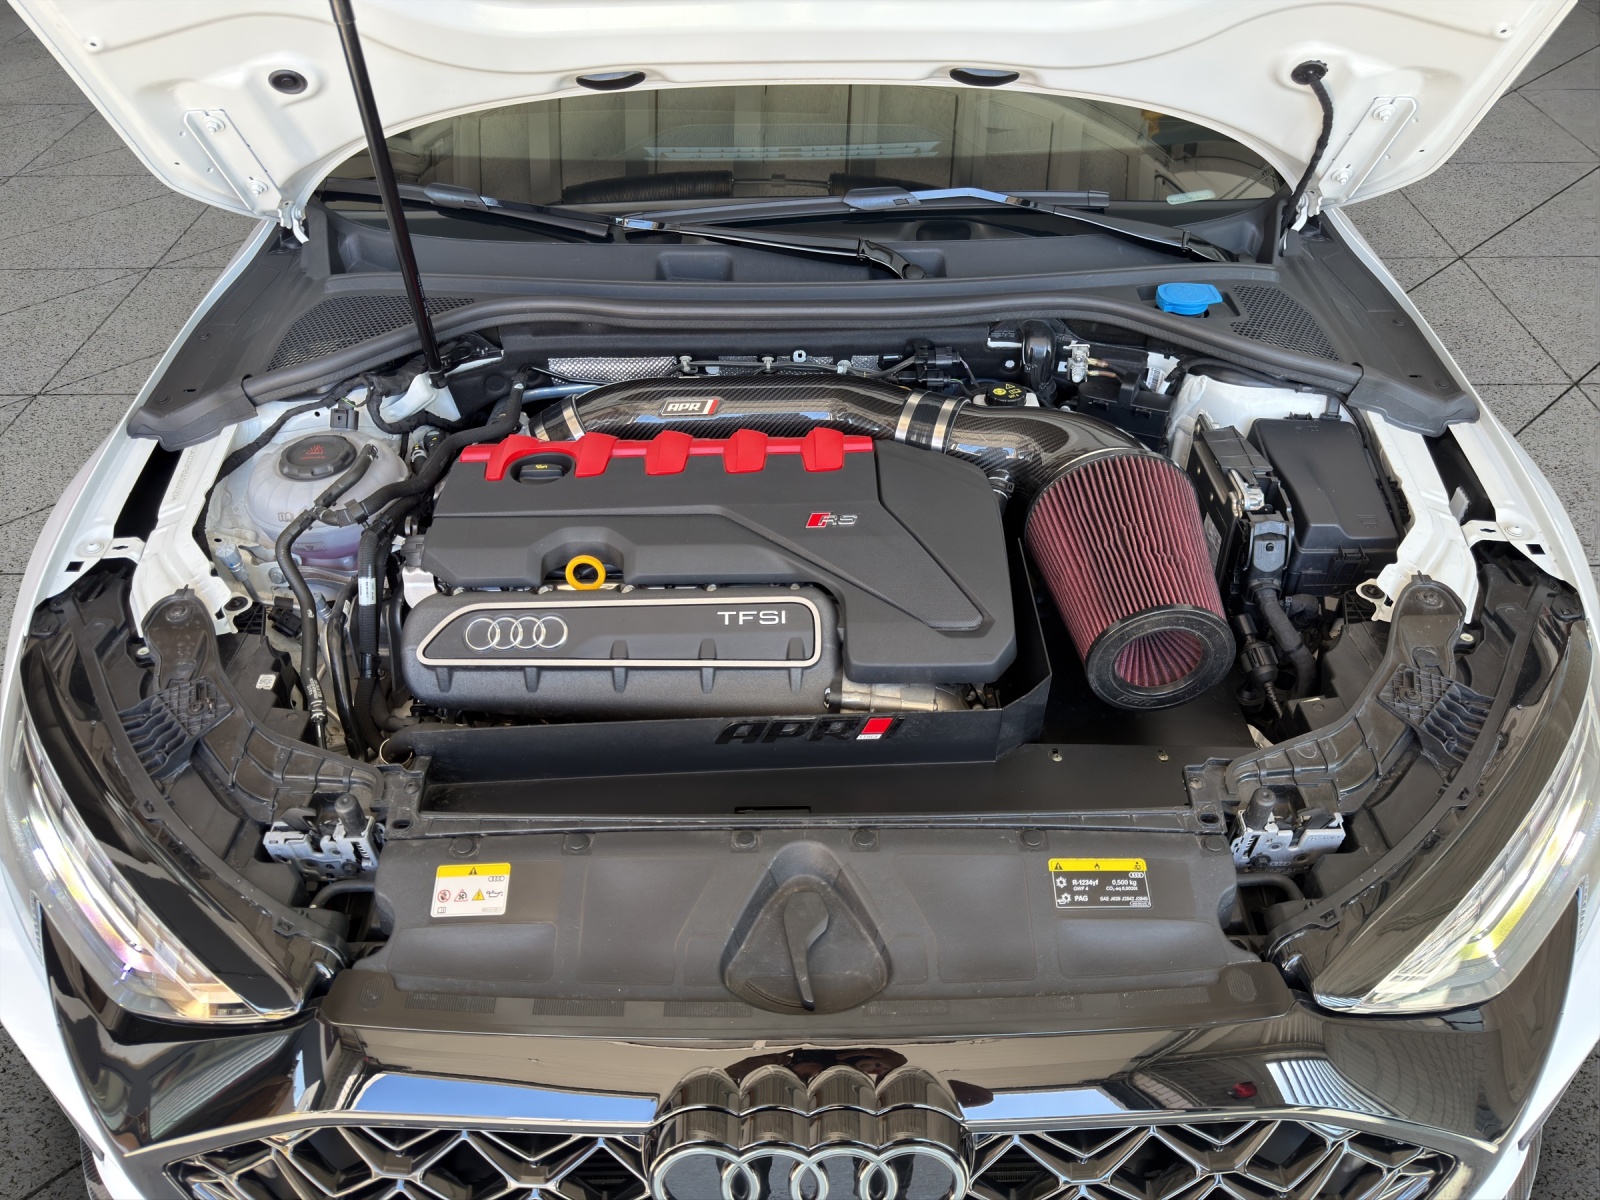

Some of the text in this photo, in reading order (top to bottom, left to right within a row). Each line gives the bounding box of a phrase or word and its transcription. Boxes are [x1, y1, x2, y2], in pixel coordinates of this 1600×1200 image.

[667, 402, 701, 411] APR
[817, 514, 858, 526] RS
[717, 610, 786, 625] TFSI
[714, 717, 861, 744] APR
[1072, 879, 1099, 887] R-1234yf
[1129, 879, 1137, 887] kg
